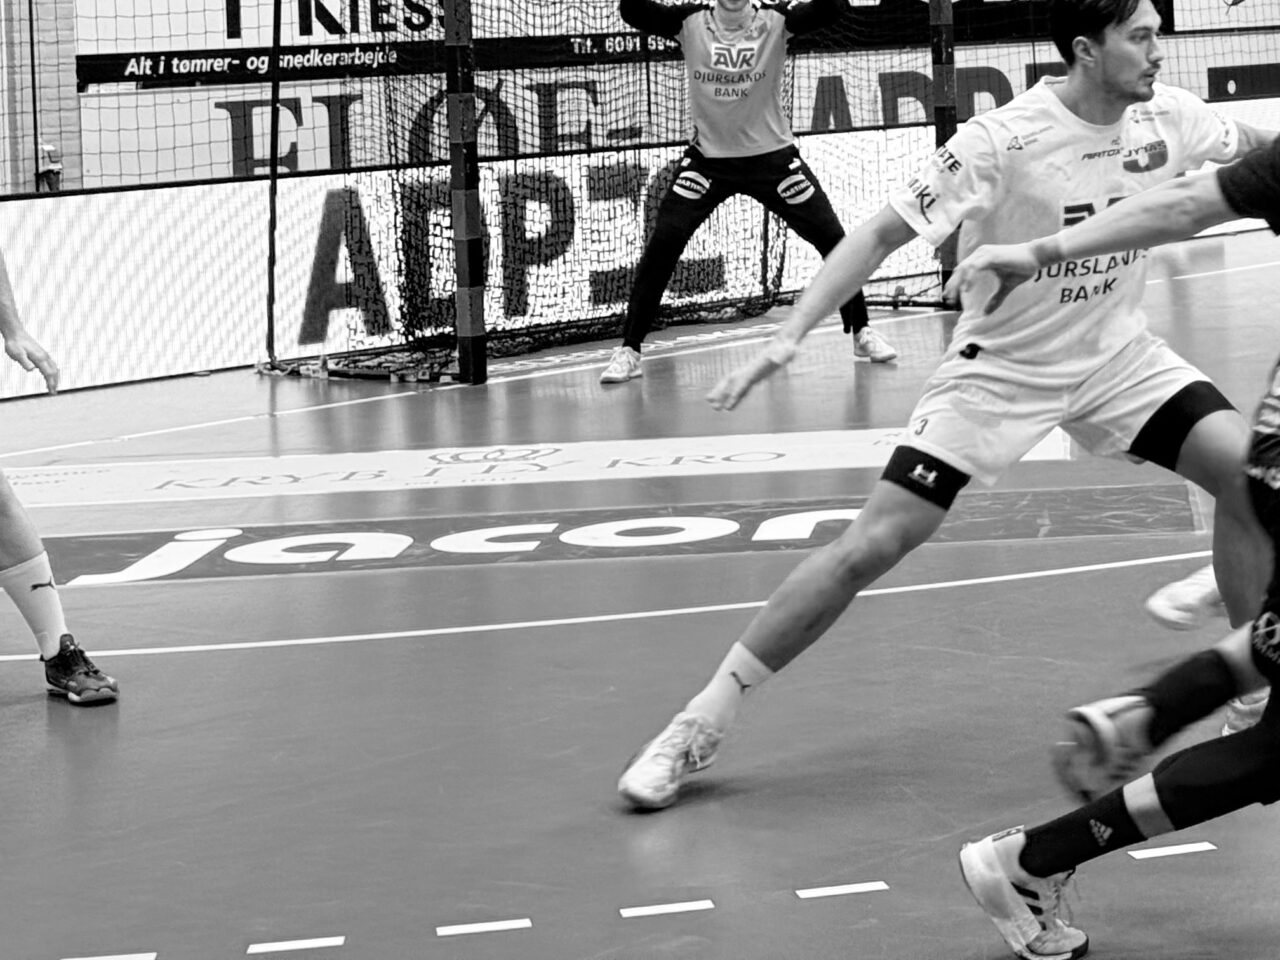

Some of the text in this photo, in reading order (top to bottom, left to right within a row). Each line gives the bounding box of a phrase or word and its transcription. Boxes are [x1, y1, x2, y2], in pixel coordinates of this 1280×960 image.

[125, 56, 152, 76] Alt
[158, 55, 166, 74] i
[171, 53, 240, 75] tømrer-
[246, 53, 269, 74] og
[713, 46, 755, 69] AVK
[714, 86, 749, 99] BANK
[607, 451, 787, 468] KRO
